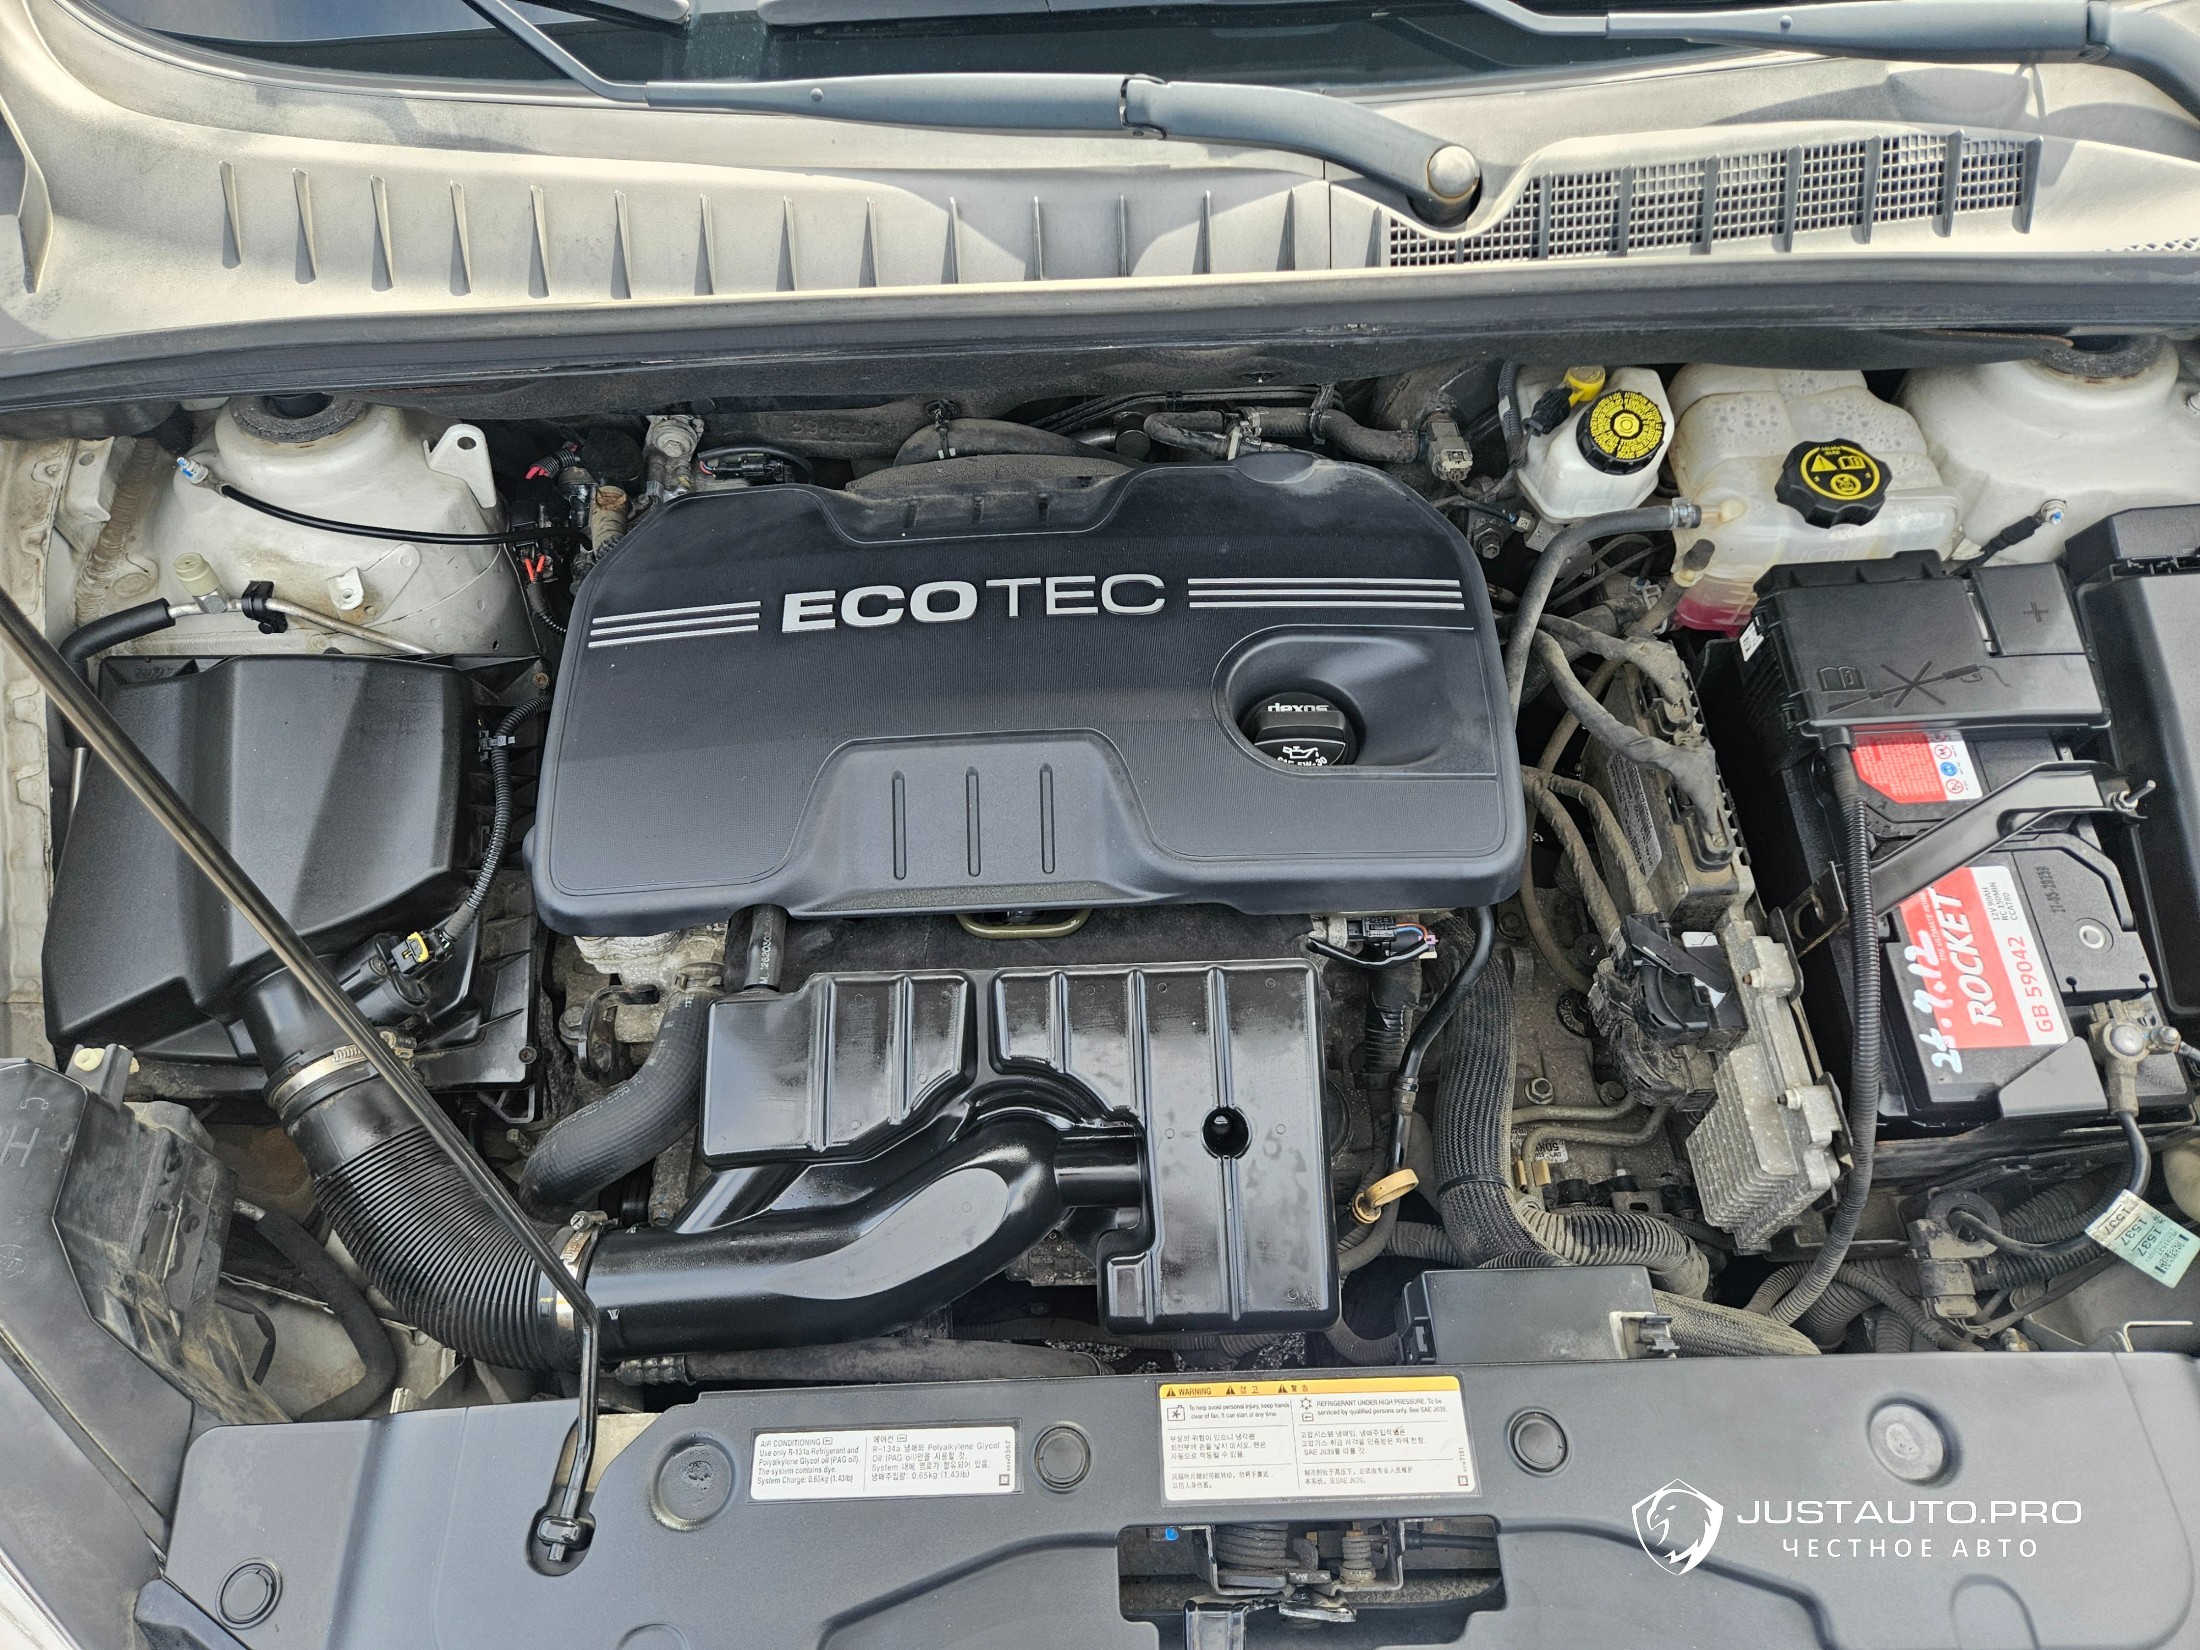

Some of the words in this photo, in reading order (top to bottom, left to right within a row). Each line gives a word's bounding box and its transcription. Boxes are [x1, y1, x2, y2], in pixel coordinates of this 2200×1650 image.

[782, 573, 1167, 633] ECOTEC
[1927, 886, 2004, 1028] ROCKET
[2008, 936, 2042, 997] 59042
[2032, 1004, 2053, 1032] GB
[2104, 1206, 2131, 1234] 1537
[2121, 1218, 2148, 1246] 1537
[2137, 1228, 2161, 1256] 1537
[1178, 1388, 1212, 1396] WARNING
[773, 1439, 821, 1447] CONDITIONING
[874, 1435, 894, 1443] 에어컨
[1170, 1435, 1190, 1443] 부상의
[1192, 1434, 1212, 1442] 위험이
[773, 1449, 786, 1458] only
[811, 1447, 846, 1456] Refrigerant
[873, 1445, 900, 1453] R-134a
[928, 1443, 973, 1451] Polyalkylene
[976, 1442, 1000, 1450] Glycol
[759, 1458, 798, 1467] Polyalkylene
[800, 1457, 820, 1466] Glycol
[830, 1456, 847, 1465] (PAG
[935, 1452, 954, 1461] 사용할
[771, 1467, 793, 1476] system
[823, 1466, 836, 1475] dye.
[872, 1464, 898, 1472] System
[944, 1460, 970, 1470] 함유되어
[757, 1477, 780, 1486] System
[782, 1476, 807, 1485] Charge:
[808, 1475, 829, 1483] 0.65kg
[911, 1471, 938, 1480] 0.65kg
[941, 1470, 970, 1479] (1.43lb)
